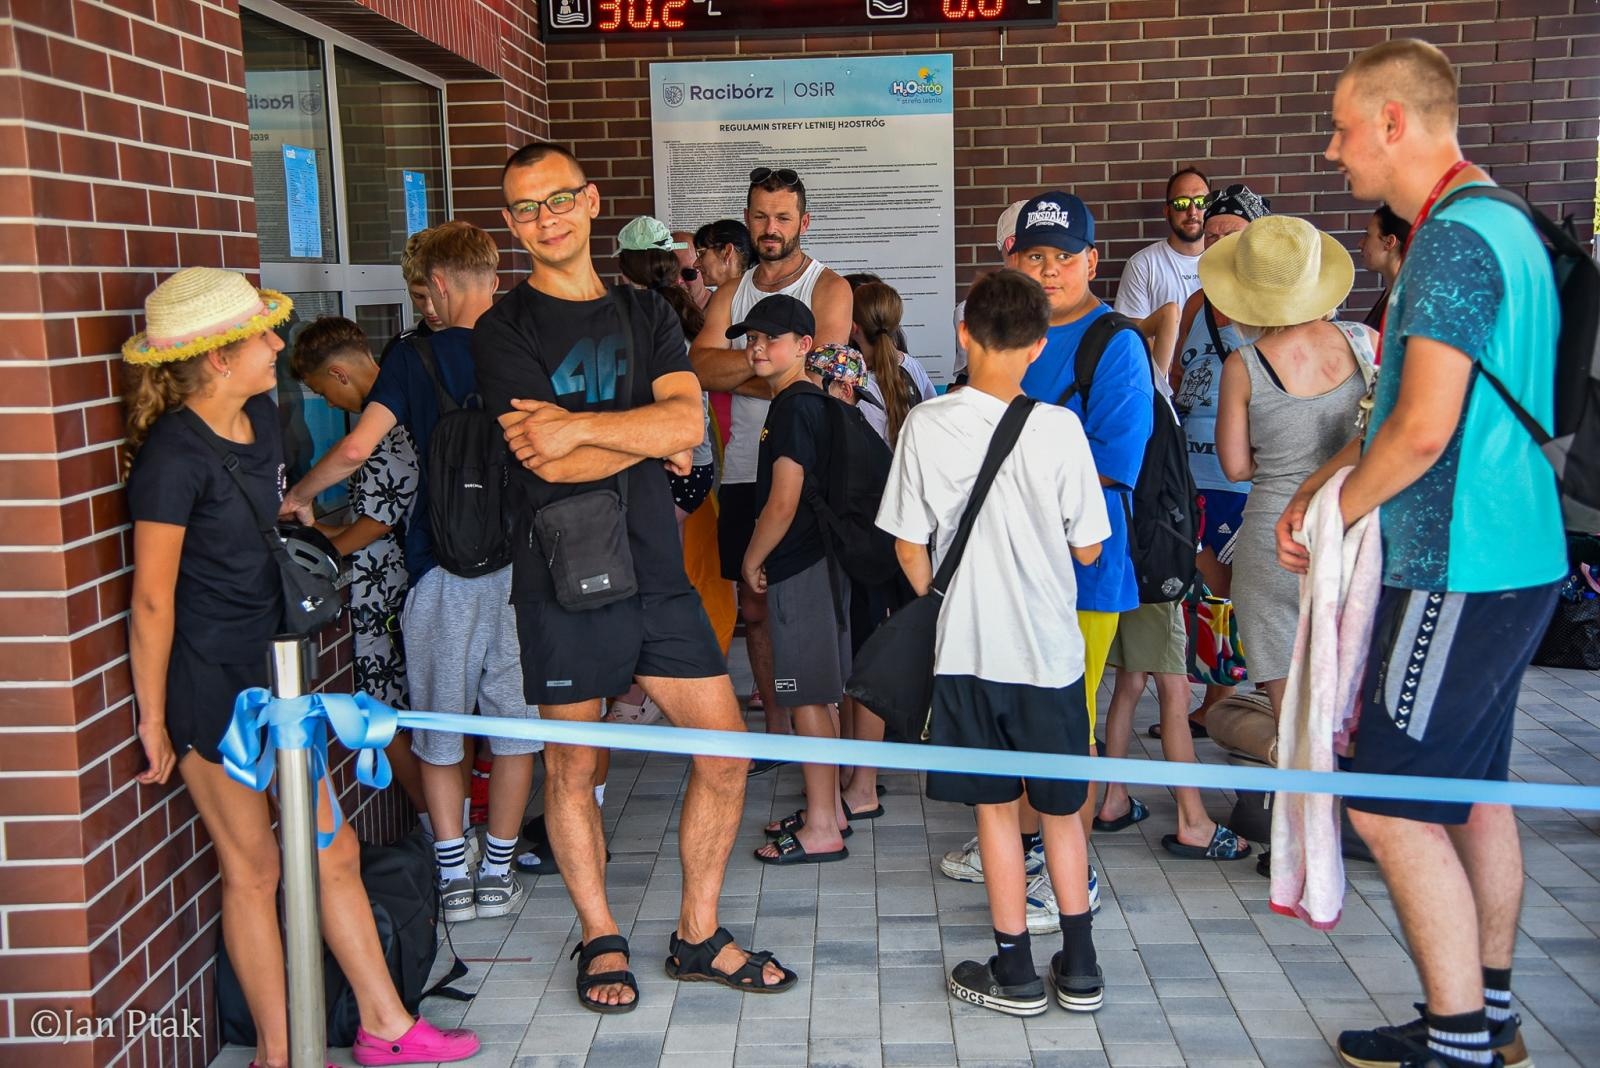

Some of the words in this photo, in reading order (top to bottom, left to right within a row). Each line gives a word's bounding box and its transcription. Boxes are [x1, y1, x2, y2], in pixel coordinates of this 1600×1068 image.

[690, 84, 774, 100] Racibórz
[794, 82, 835, 97] OSiR
[720, 123, 770, 132] REGULAMIN
[771, 121, 803, 131] STREFY
[805, 120, 836, 130] LETNIEJ
[838, 118, 886, 129] H2OSTRÓG
[950, 981, 985, 1005] crocs
